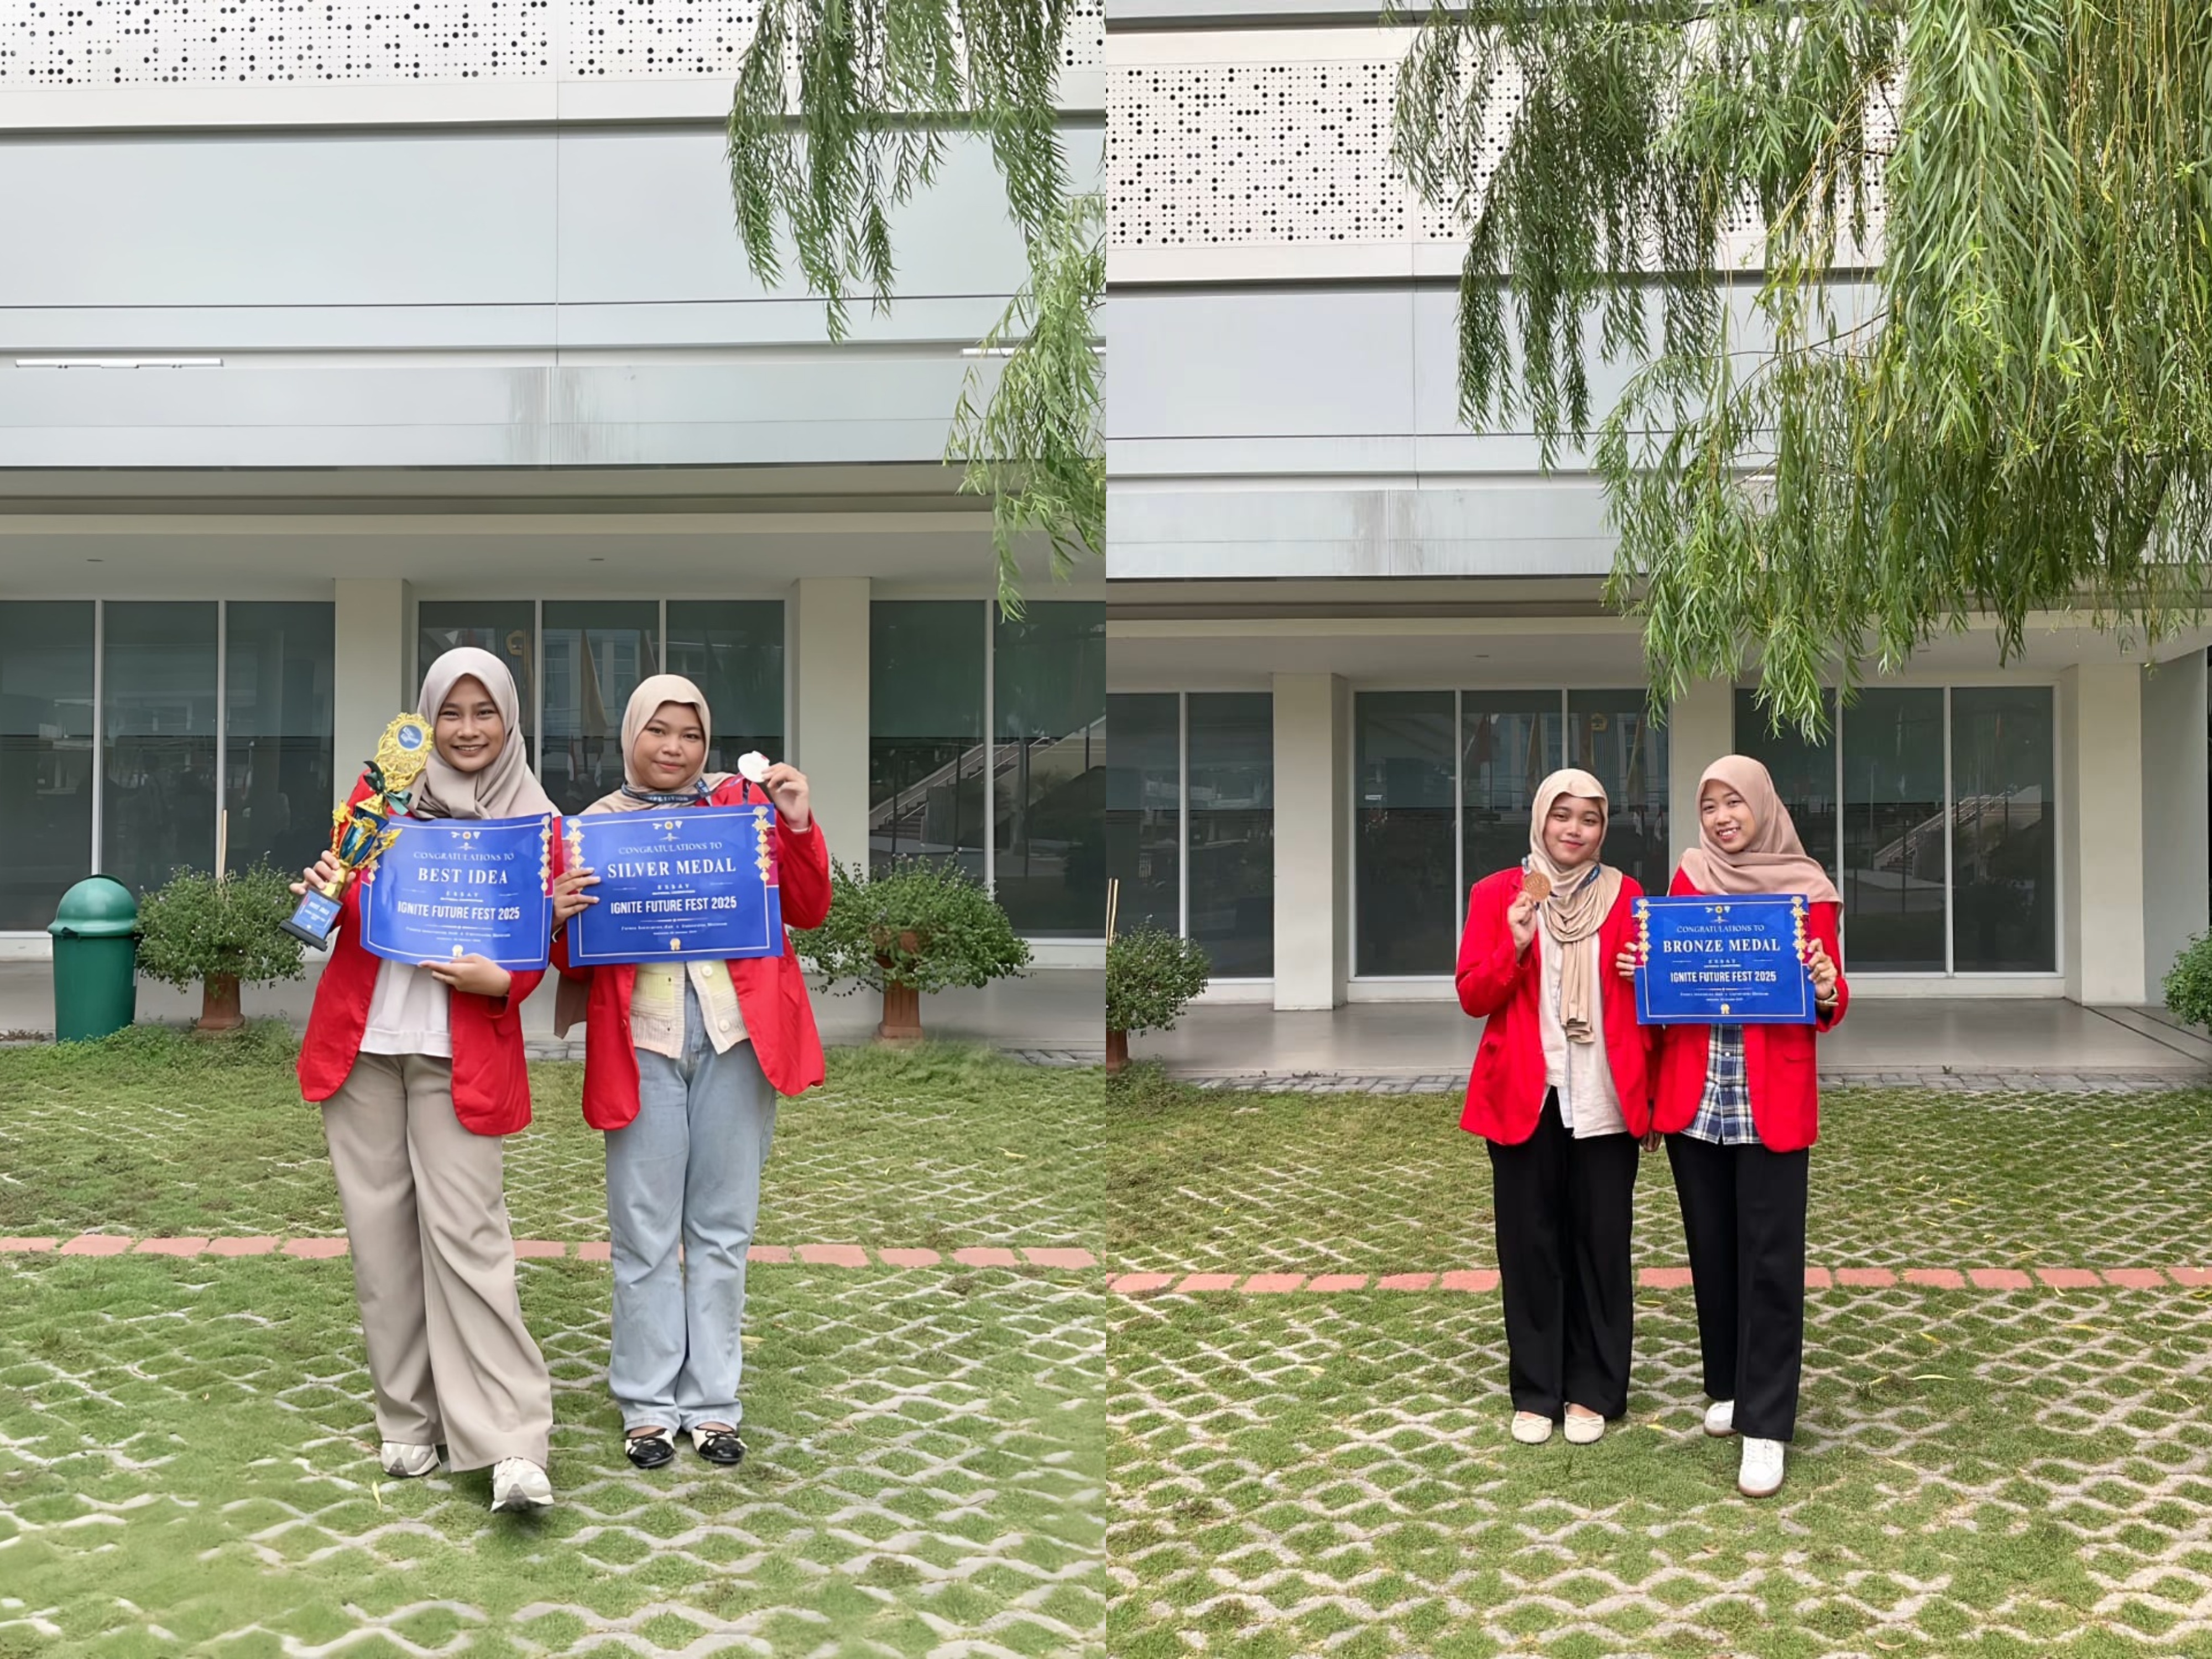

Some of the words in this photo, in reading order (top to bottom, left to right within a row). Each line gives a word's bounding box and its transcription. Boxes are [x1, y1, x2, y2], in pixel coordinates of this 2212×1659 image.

[618, 842, 707, 854] CONGRATULATIONS
[414, 852, 501, 861] CONGRATULATIONS
[504, 852, 514, 860] TO
[418, 867, 462, 883] BEST
[468, 869, 508, 884] IDEA
[607, 861, 670, 878] SILVER
[676, 858, 736, 875] MEDAL
[398, 901, 430, 916] IGNITE
[431, 905, 469, 919] FUTURE
[471, 907, 496, 920] FEST
[498, 906, 520, 920] 2025
[611, 901, 643, 914] IGNITE
[646, 899, 683, 912] FUTURE
[685, 898, 709, 911] FEST
[711, 896, 737, 909] 2025
[1677, 925, 1752, 933] CONGRATULATIONS
[1663, 940, 1723, 953] BRONZE
[1729, 938, 1781, 951] MEDAL
[1670, 972, 1698, 983] IGNITE
[1699, 971, 1730, 983] FUTURE
[1732, 971, 1753, 982] FEST
[1754, 971, 1777, 982] 2025
